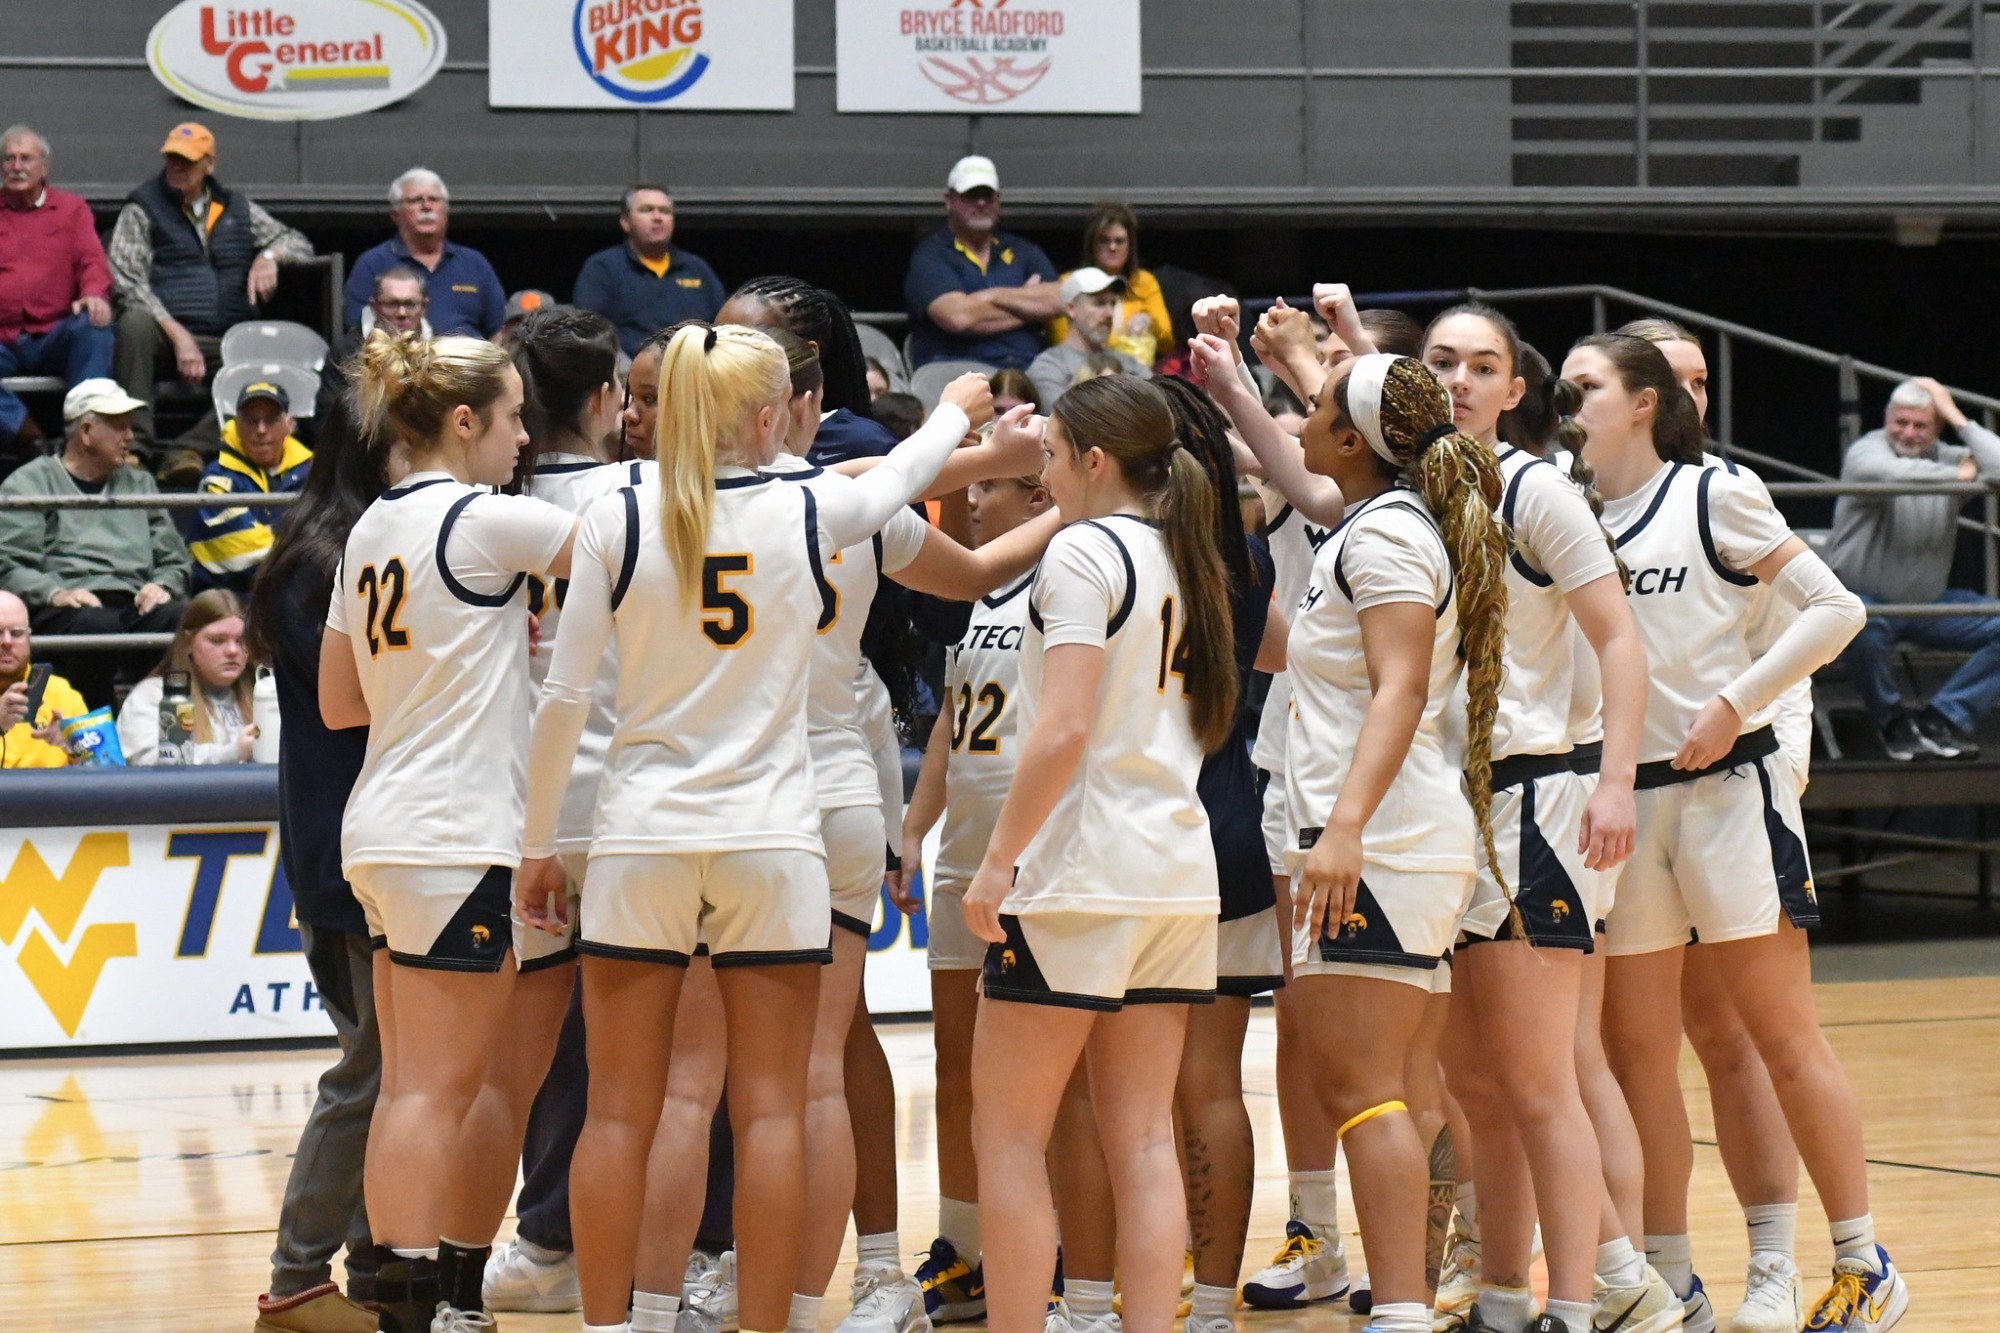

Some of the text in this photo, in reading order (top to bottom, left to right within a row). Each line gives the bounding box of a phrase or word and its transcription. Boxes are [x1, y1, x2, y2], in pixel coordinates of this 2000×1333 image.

[200, 7, 295, 56] Little
[595, 8, 702, 73] KING
[901, 10, 1064, 36] BRYCE RADFORD
[915, 37, 1047, 51] BASKETBALL ACADEMY
[227, 33, 383, 93] General
[358, 556, 411, 660] 22
[700, 553, 753, 650] 5
